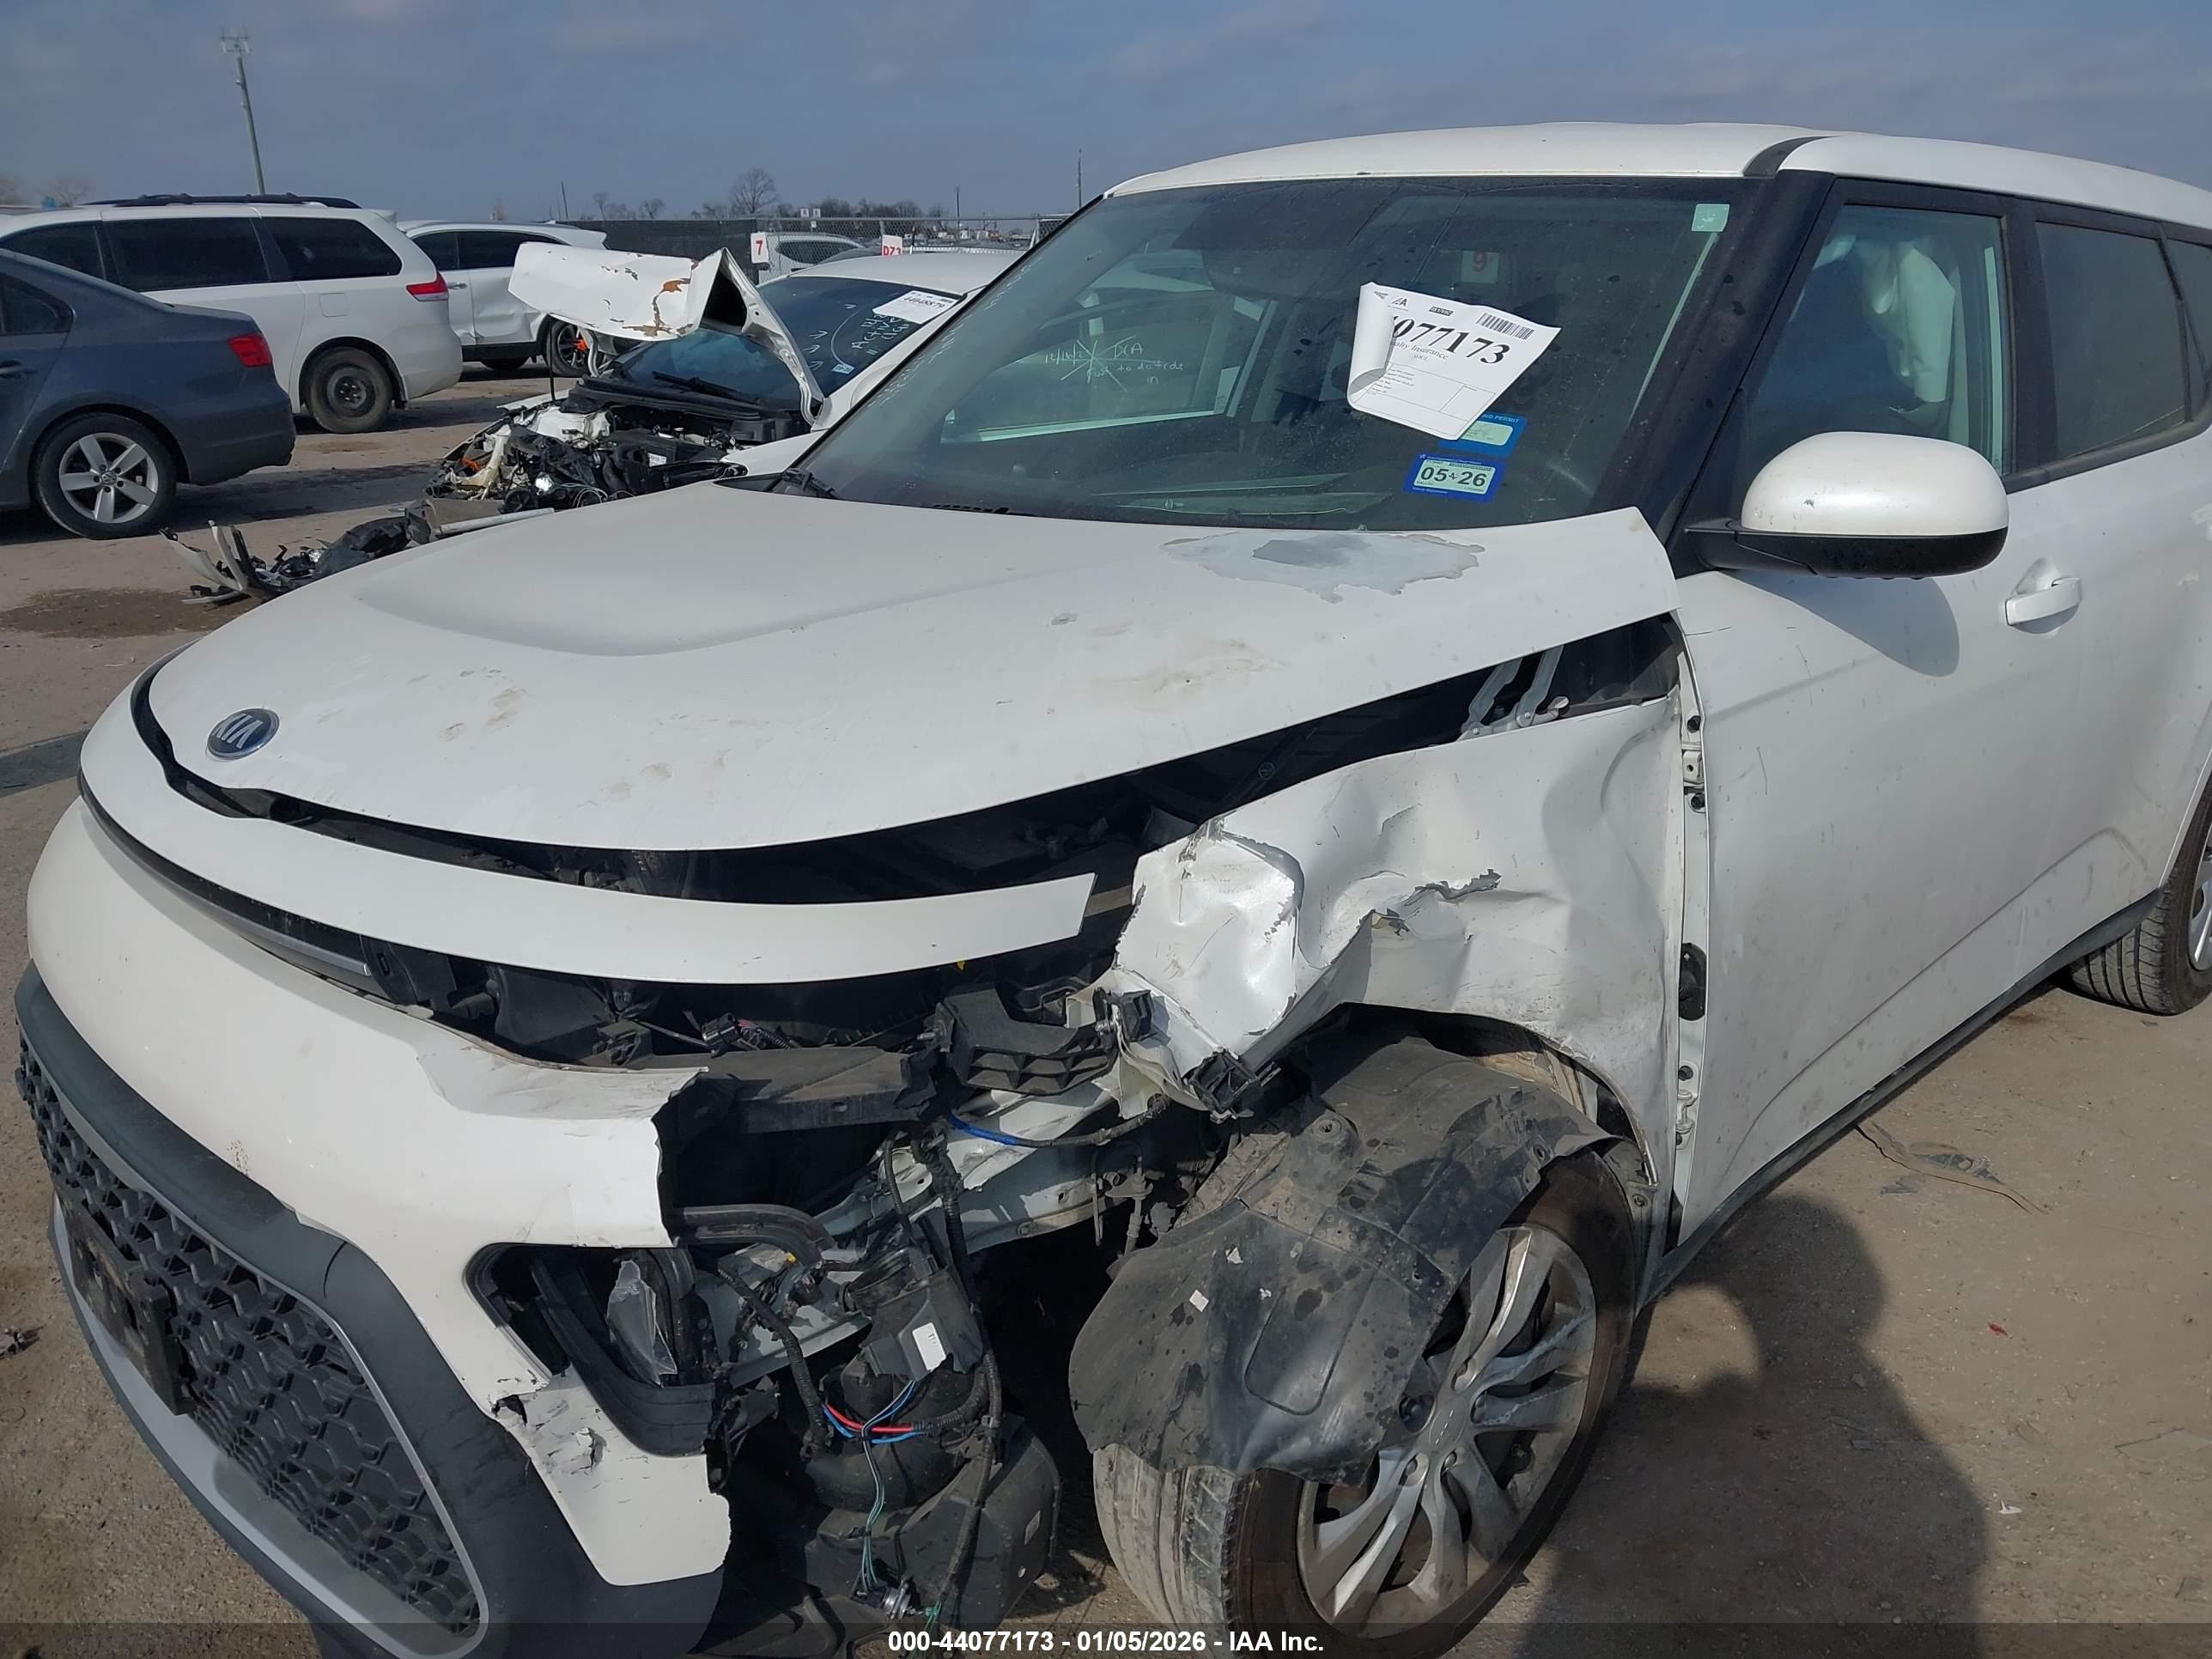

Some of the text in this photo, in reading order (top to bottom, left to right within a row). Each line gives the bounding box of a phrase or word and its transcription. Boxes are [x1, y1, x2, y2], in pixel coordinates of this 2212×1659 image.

[756, 240, 763, 255] 7
[1393, 315, 1510, 363] 077173
[1411, 344, 1449, 360] Insurance
[1420, 467, 1449, 482] 05
[1457, 471, 1487, 487] 26
